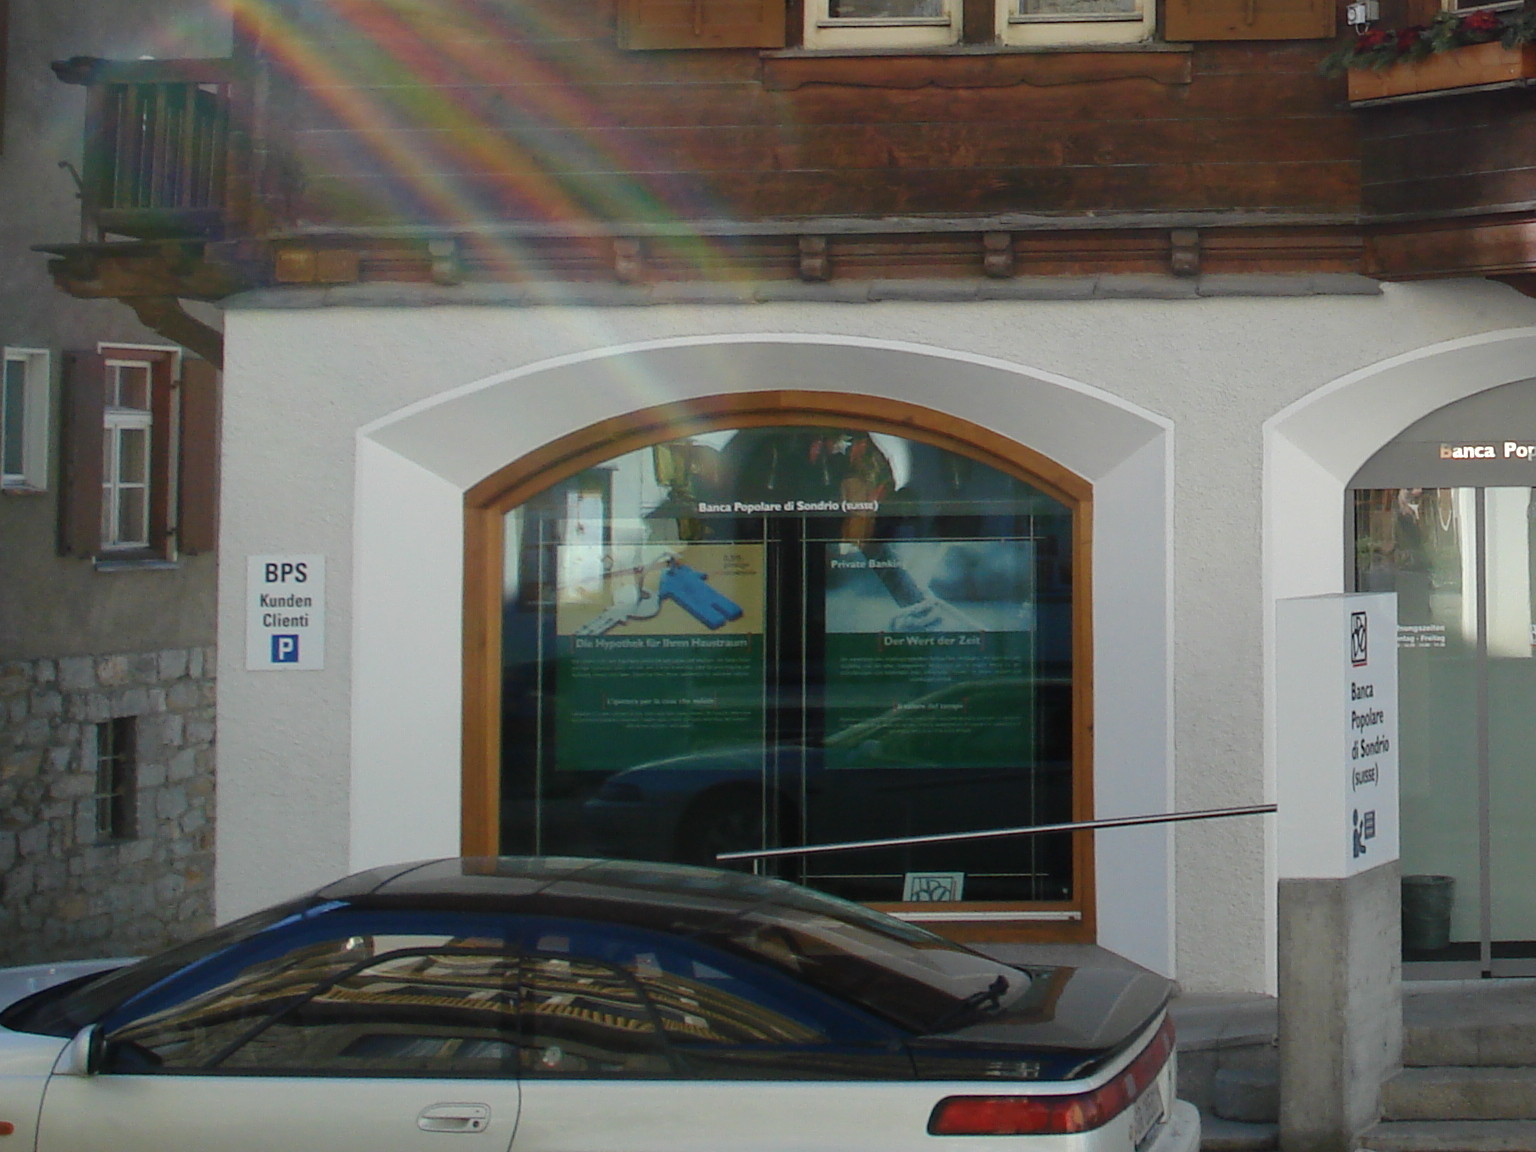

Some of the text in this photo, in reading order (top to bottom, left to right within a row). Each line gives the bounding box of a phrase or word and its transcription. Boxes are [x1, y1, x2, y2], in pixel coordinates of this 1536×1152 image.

[1439, 442, 1496, 460] Banca
[698, 501, 732, 513] Banca
[733, 500, 782, 516] Popolare
[783, 500, 795, 512] di
[796, 499, 839, 512] Sondrio
[264, 562, 308, 584] BPS
[831, 559, 866, 569] Private
[259, 593, 312, 608] Kunden
[263, 612, 309, 627] Clienti
[278, 636, 295, 661] P
[883, 635, 981, 647] Der Wert der Zeit
[1350, 681, 1374, 702] Banca
[1351, 707, 1384, 734] Popolare
[1351, 733, 1390, 760] di Sondrio
